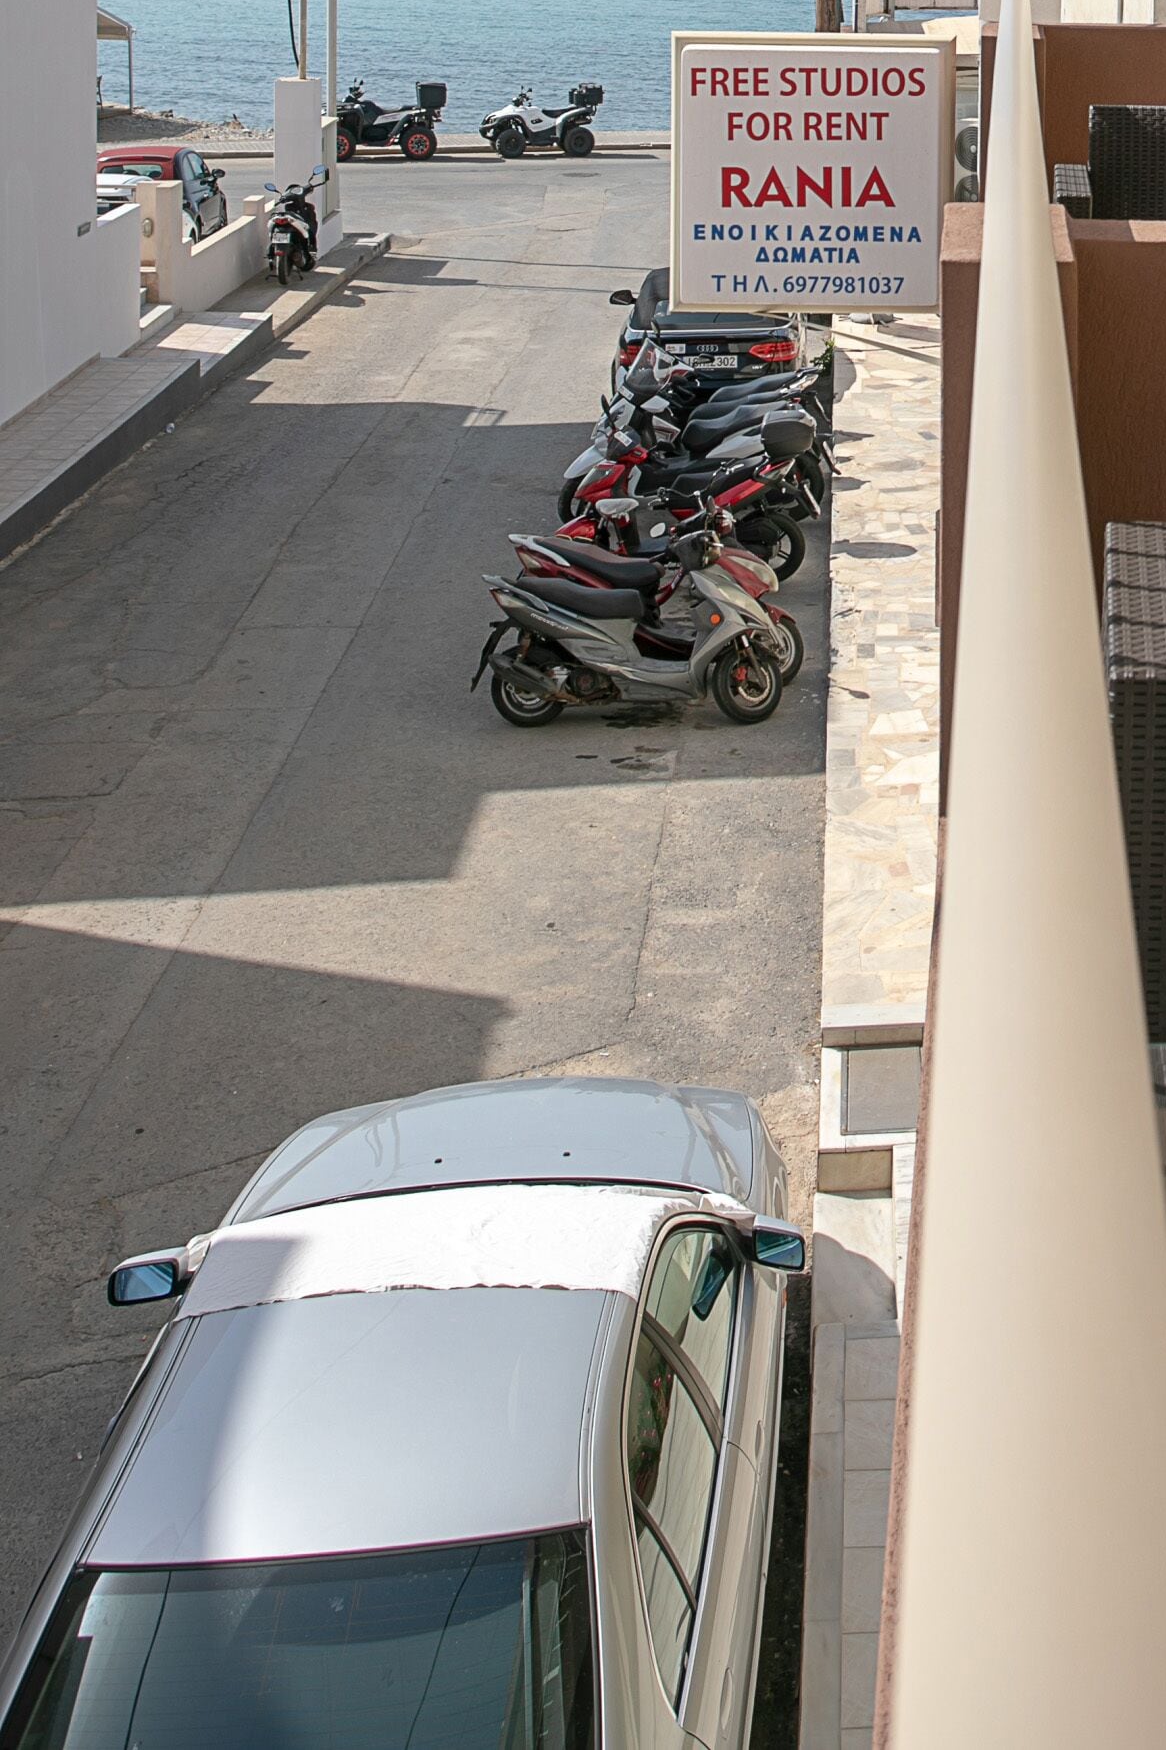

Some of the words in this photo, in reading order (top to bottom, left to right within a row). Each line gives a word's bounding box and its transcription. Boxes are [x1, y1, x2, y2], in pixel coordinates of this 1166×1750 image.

[690, 67, 770, 97] FREE
[779, 67, 926, 97] STUDIOS
[727, 112, 793, 141] FOR
[804, 112, 890, 141] RENT
[721, 165, 896, 209] RANIA
[693, 224, 922, 243] ΕΝΟΙΚΙΑΖΟΜΕΝΑ
[755, 246, 860, 264] ΔΩΜΑΤΙΑ
[783, 275, 905, 295] 6977981037
